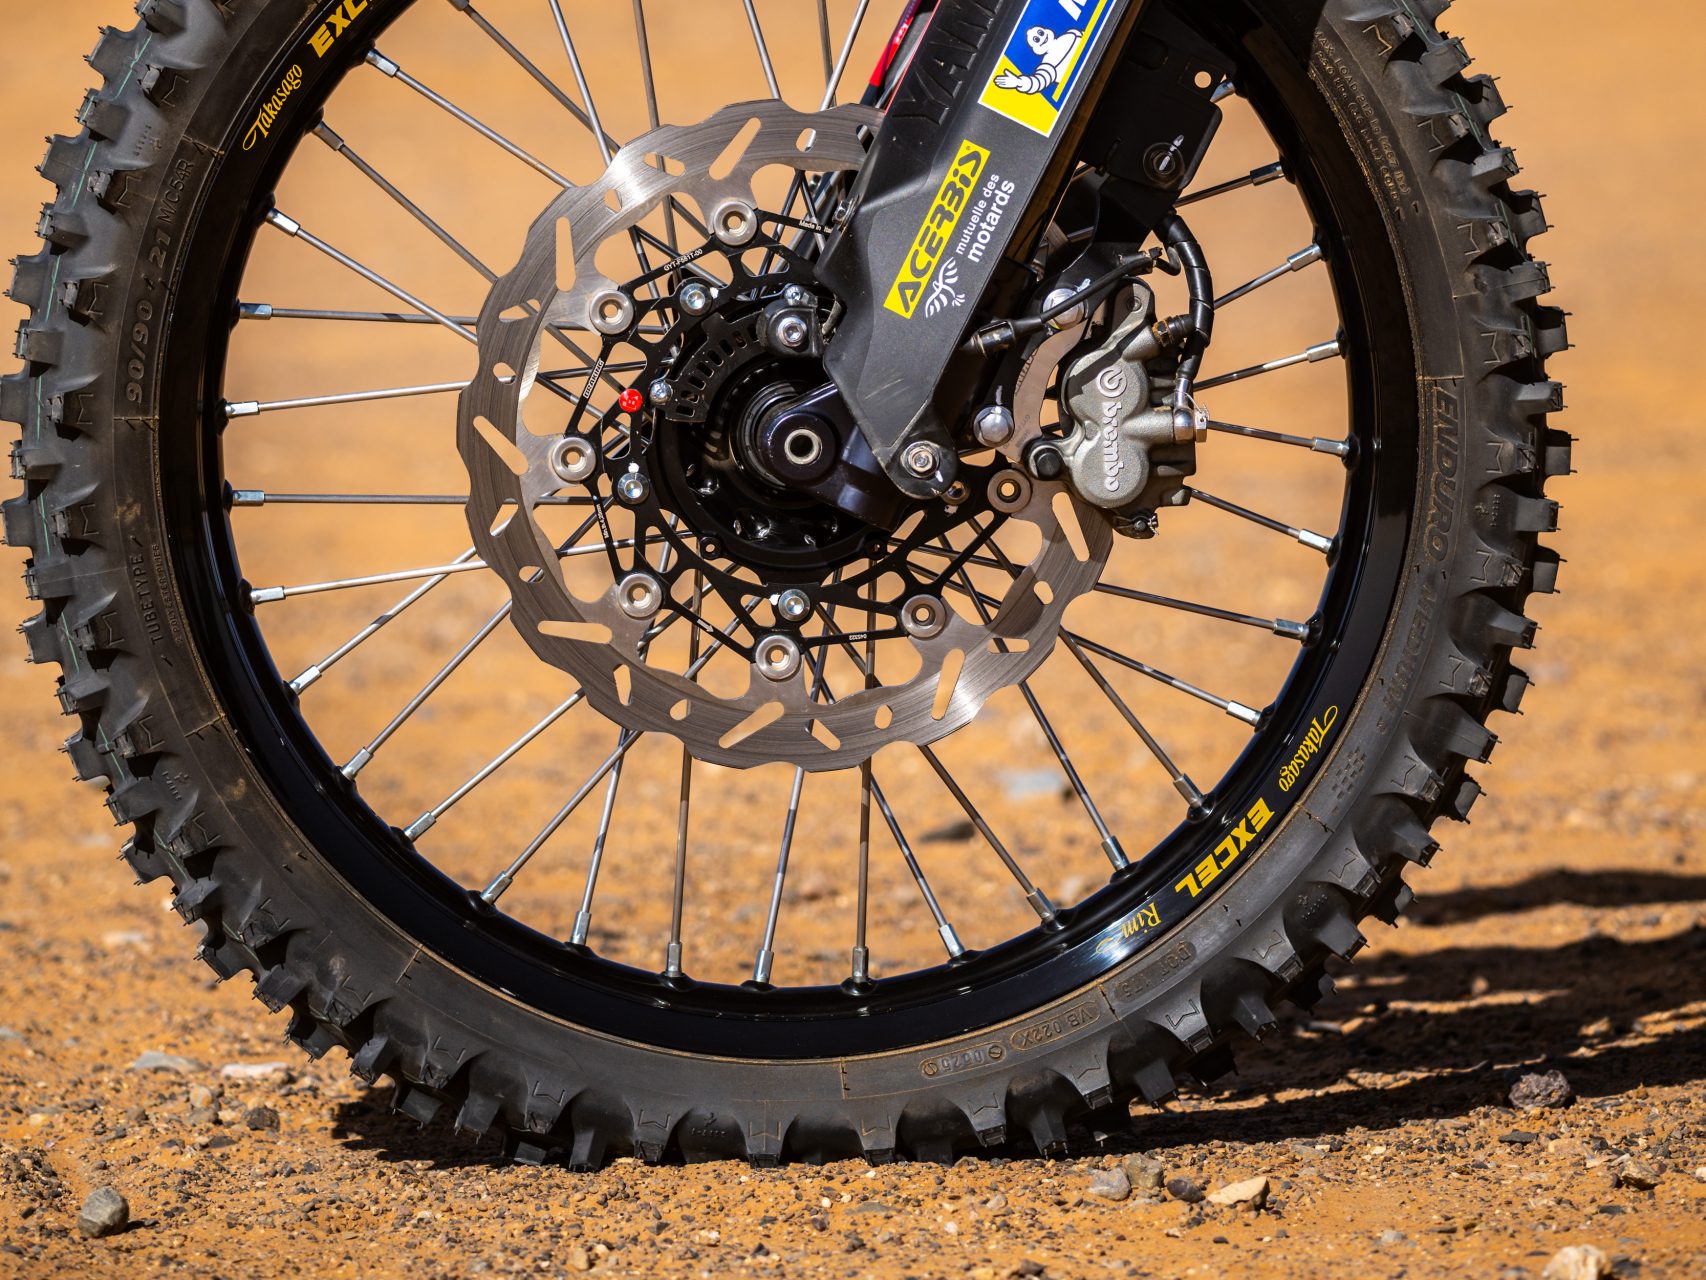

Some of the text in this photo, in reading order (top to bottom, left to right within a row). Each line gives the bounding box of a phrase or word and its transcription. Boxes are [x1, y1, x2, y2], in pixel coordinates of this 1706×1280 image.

[242, 64, 302, 150] Takasago
[899, 149, 984, 316] ACERBIS
[956, 173, 1000, 256] mutuelle des
[967, 179, 1015, 263] motards
[126, 299, 153, 405] 90/90
[148, 229, 171, 270] 21
[582, 358, 605, 398] BRAKING
[1102, 401, 1124, 493] brembo
[1423, 387, 1458, 562] ENDURO
[130, 553, 164, 645] TUBETYPE
[152, 544, 168, 571] PLIES
[156, 571, 182, 634] POLYESTER
[1096, 705, 1338, 954] Takasago EXCEL Rim
[1018, 1006, 1093, 1046] VB 022X
